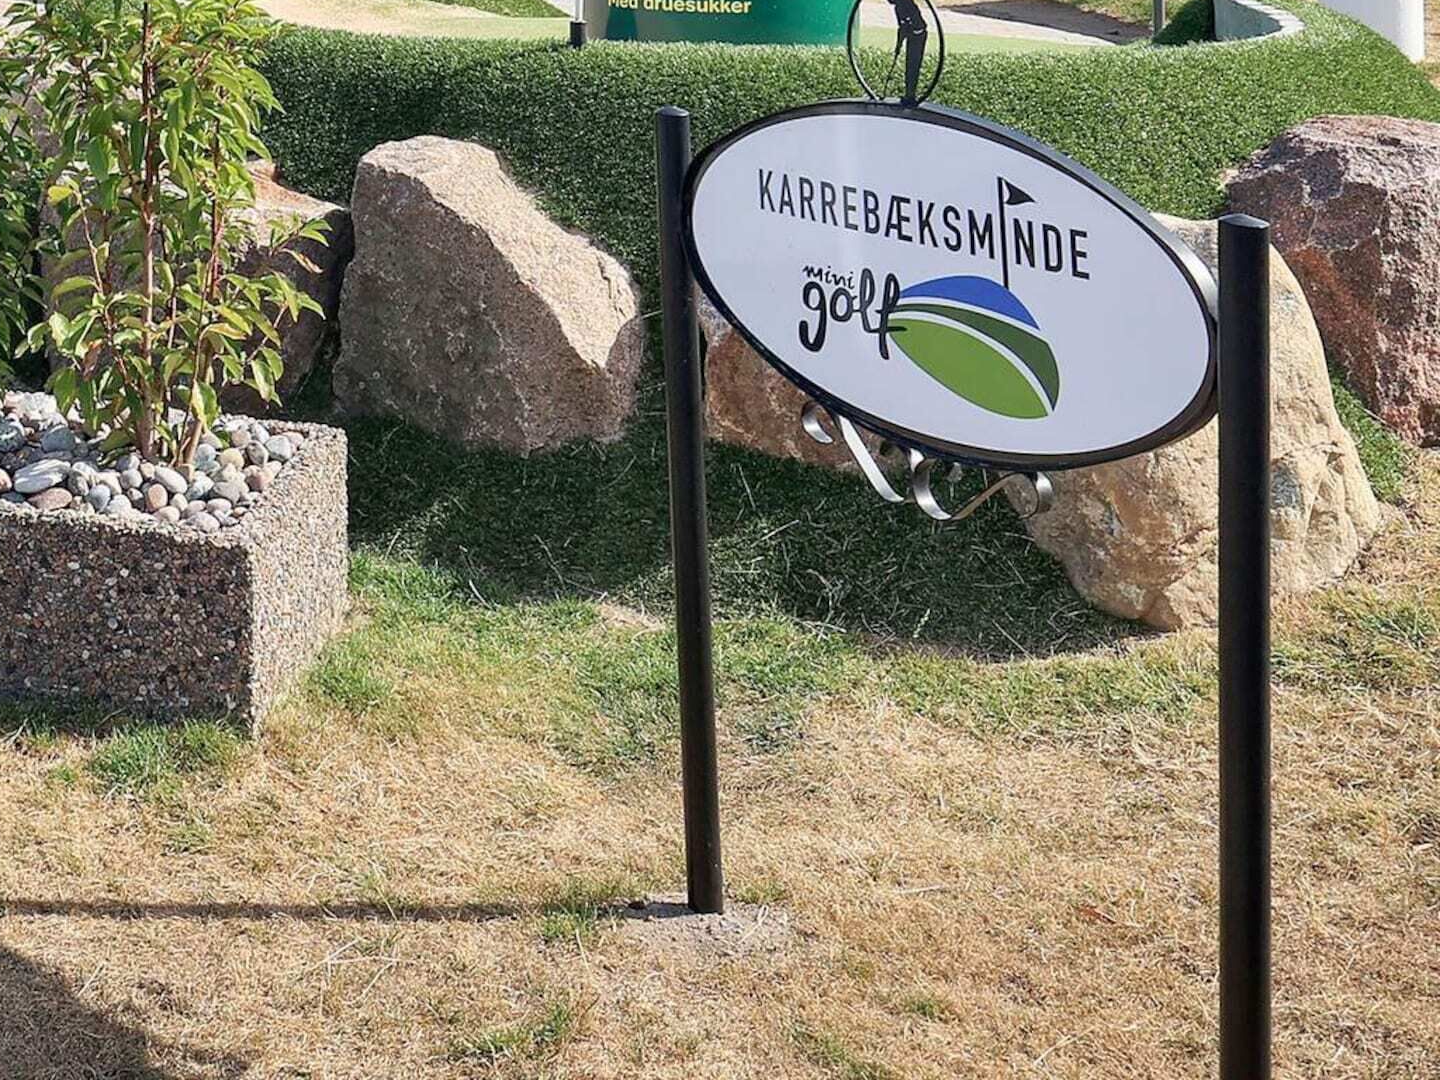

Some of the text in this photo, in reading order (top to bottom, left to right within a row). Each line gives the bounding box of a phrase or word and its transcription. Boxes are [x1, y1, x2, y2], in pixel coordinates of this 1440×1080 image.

[758, 168, 1091, 280] KARREBÆKSMINDE
[798, 268, 906, 361] golf
[801, 265, 856, 291] mini
